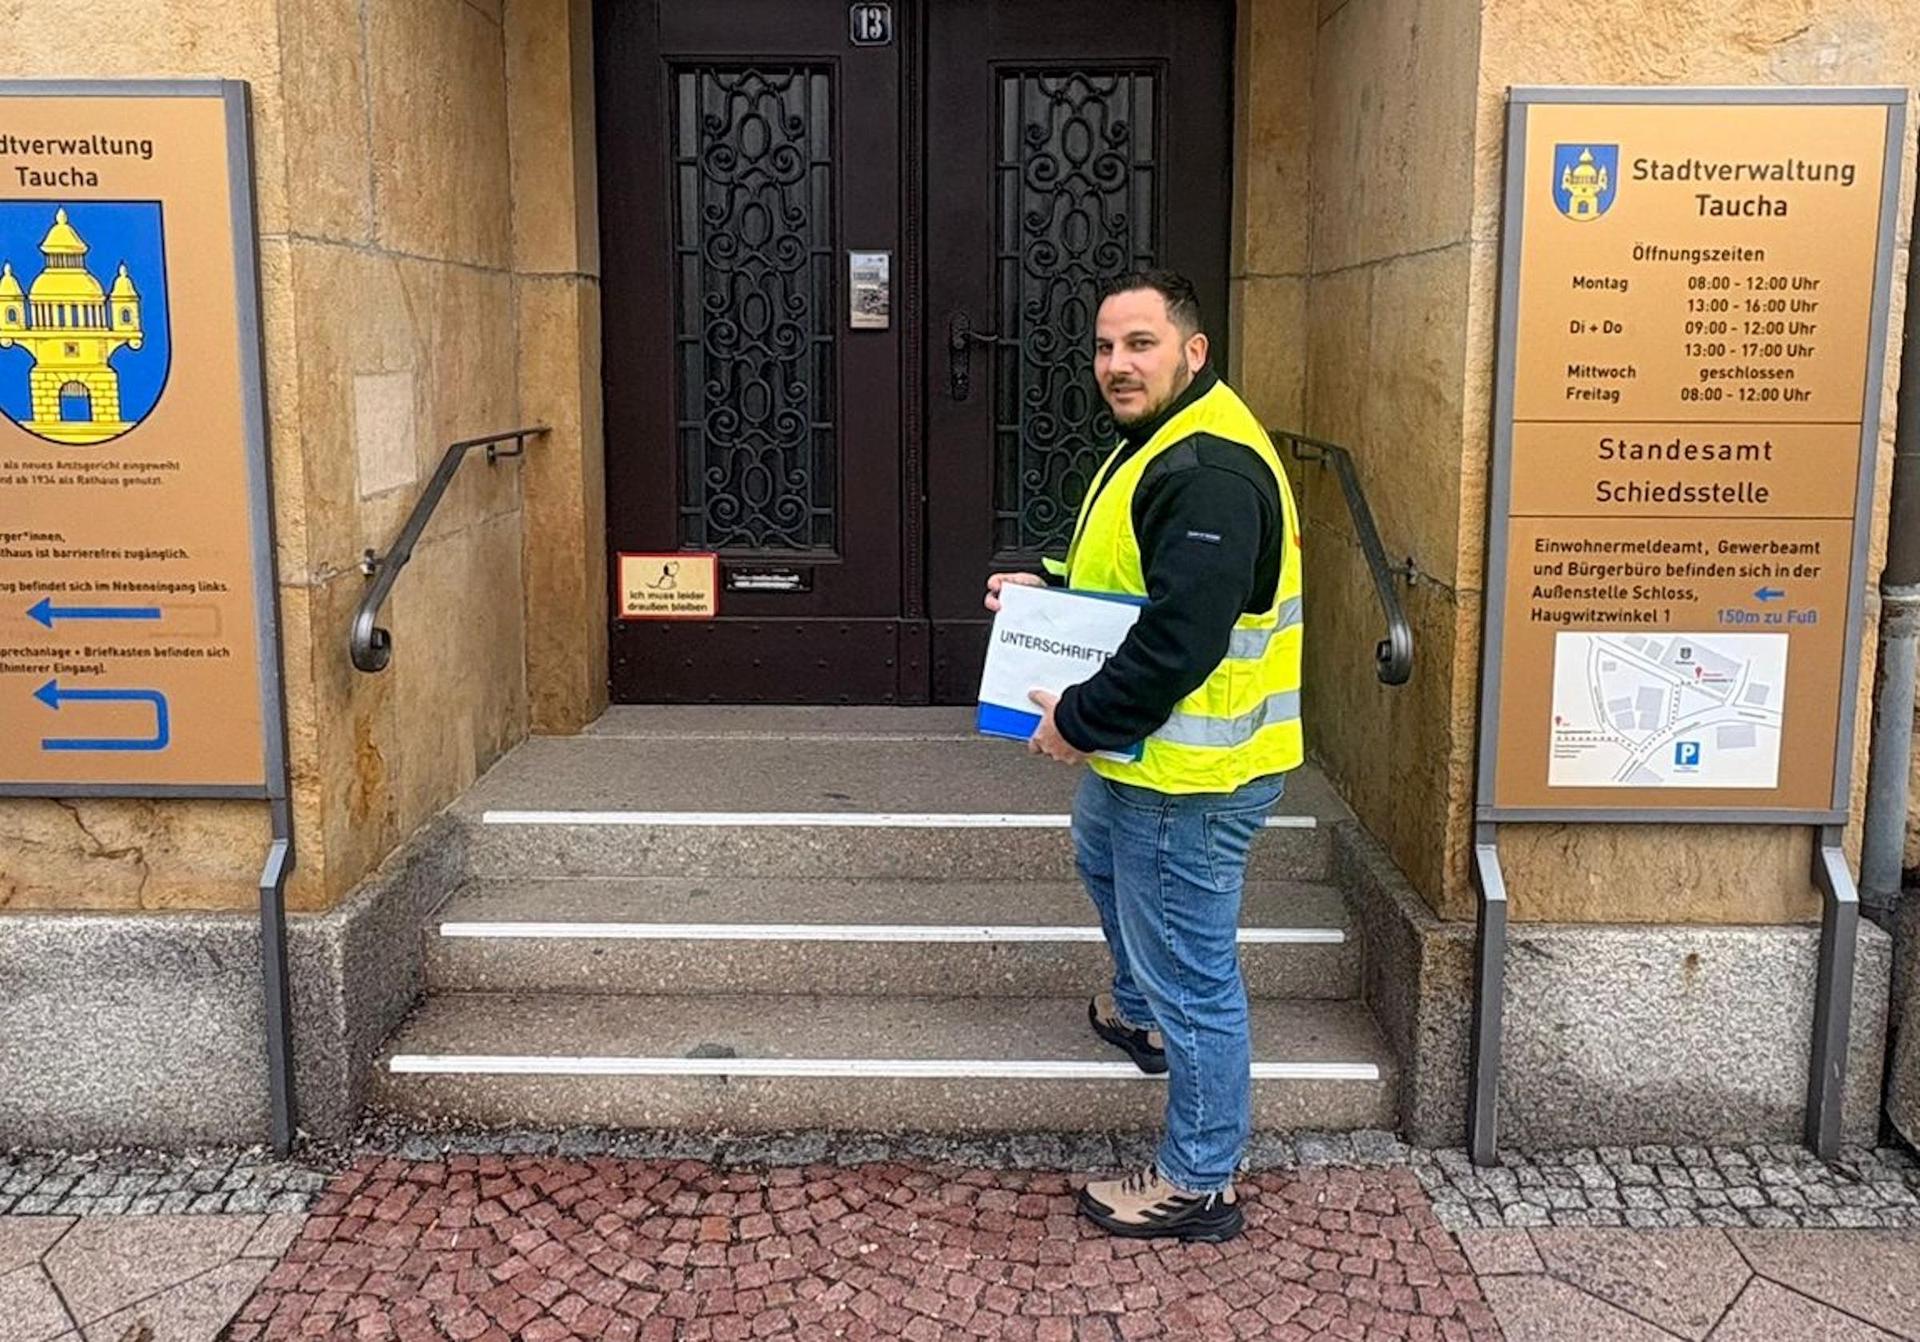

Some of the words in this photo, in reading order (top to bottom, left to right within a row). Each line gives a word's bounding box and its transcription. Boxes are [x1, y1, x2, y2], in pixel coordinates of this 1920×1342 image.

[858, 7, 882, 39] 13
[15, 166, 99, 187] Taucha
[1632, 158, 1856, 186] Stadtverwaltung
[1695, 194, 1788, 217] Taucha
[1632, 242, 1765, 264] Öffnungszeiten
[1572, 276, 1628, 292] Montag
[1688, 276, 1730, 291] 08:00
[1746, 276, 1787, 291] 12:00
[1791, 276, 1820, 291] Uhr
[1688, 298, 1729, 313] 13:00
[1745, 298, 1786, 313] 16:00
[1790, 298, 1818, 313] Uhr
[1569, 320, 1585, 334] Di
[1603, 320, 1622, 334] Do
[1685, 321, 1727, 335] 09:00
[1744, 321, 1784, 335] 12:00
[1788, 321, 1817, 335] Uhr
[1685, 343, 1725, 357] 13:00
[1742, 343, 1782, 357] 17:00
[1786, 343, 1815, 357] Uhr
[1568, 364, 1636, 378] Mittwoch
[1700, 366, 1795, 382] geschlossen
[1566, 387, 1620, 403] Freitag
[1681, 387, 1722, 401] 08:00
[1738, 387, 1779, 401] 12:00
[1784, 387, 1811, 401] Uhr
[1598, 438, 1773, 461] Standesamt
[1596, 480, 1770, 503] Schiedsstelle
[36, 548, 49, 558] ist
[53, 548, 121, 558] barrierefrei
[1535, 538, 1710, 556] Einwohnermeldeamt,
[1718, 539, 1820, 554] Gewerbeamt
[1533, 562, 1562, 576] und
[1567, 561, 1661, 580] Bürgerbüro
[1666, 562, 1735, 577] befinden
[1739, 563, 1771, 578] sich
[1775, 564, 1790, 578] in
[1792, 563, 1820, 578] der
[19, 581, 66, 591] befindet
[69, 582, 92, 591] sich
[95, 582, 110, 591] im
[113, 582, 196, 593] Nebeneingang
[1532, 585, 1628, 600] Außenstelle
[1632, 585, 1699, 602] Schloss,
[1531, 608, 1658, 626] Haugwitzwinkel
[1664, 608, 1671, 623] 1
[1717, 609, 1760, 623] 150m
[1764, 612, 1782, 623] zu
[1787, 610, 1817, 624] Fuß
[84, 646, 150, 657] Briefkasten
[154, 647, 206, 657] befinden
[207, 647, 230, 657] sich
